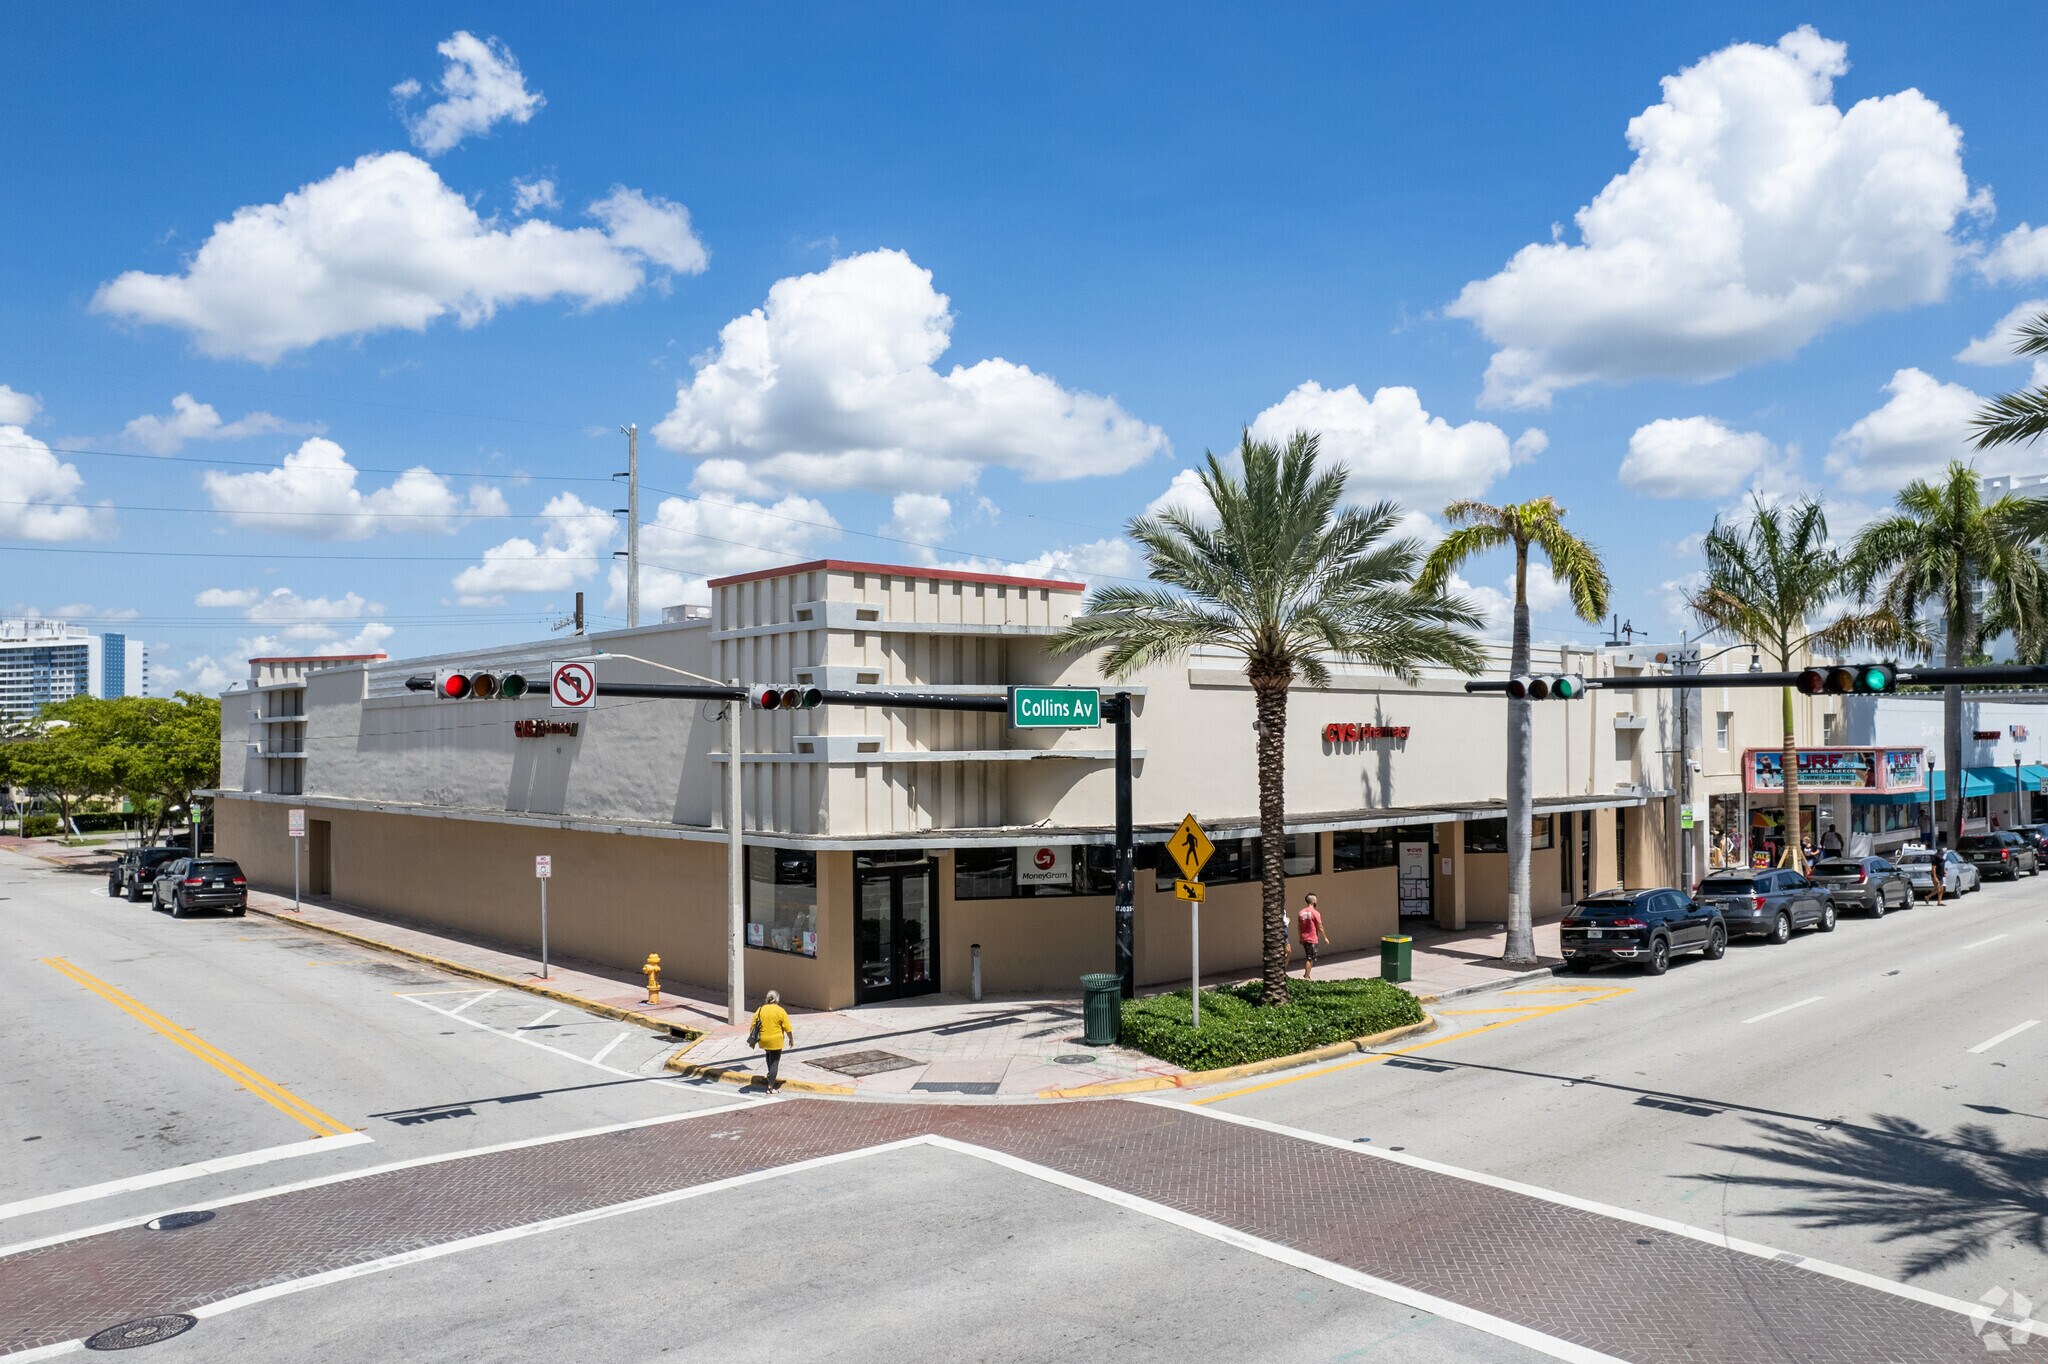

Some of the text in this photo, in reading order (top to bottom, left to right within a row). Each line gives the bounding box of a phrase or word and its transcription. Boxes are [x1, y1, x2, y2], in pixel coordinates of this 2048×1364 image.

[1021, 698, 1093, 718] Collins Av
[1022, 872, 1068, 881] MoneyGram
